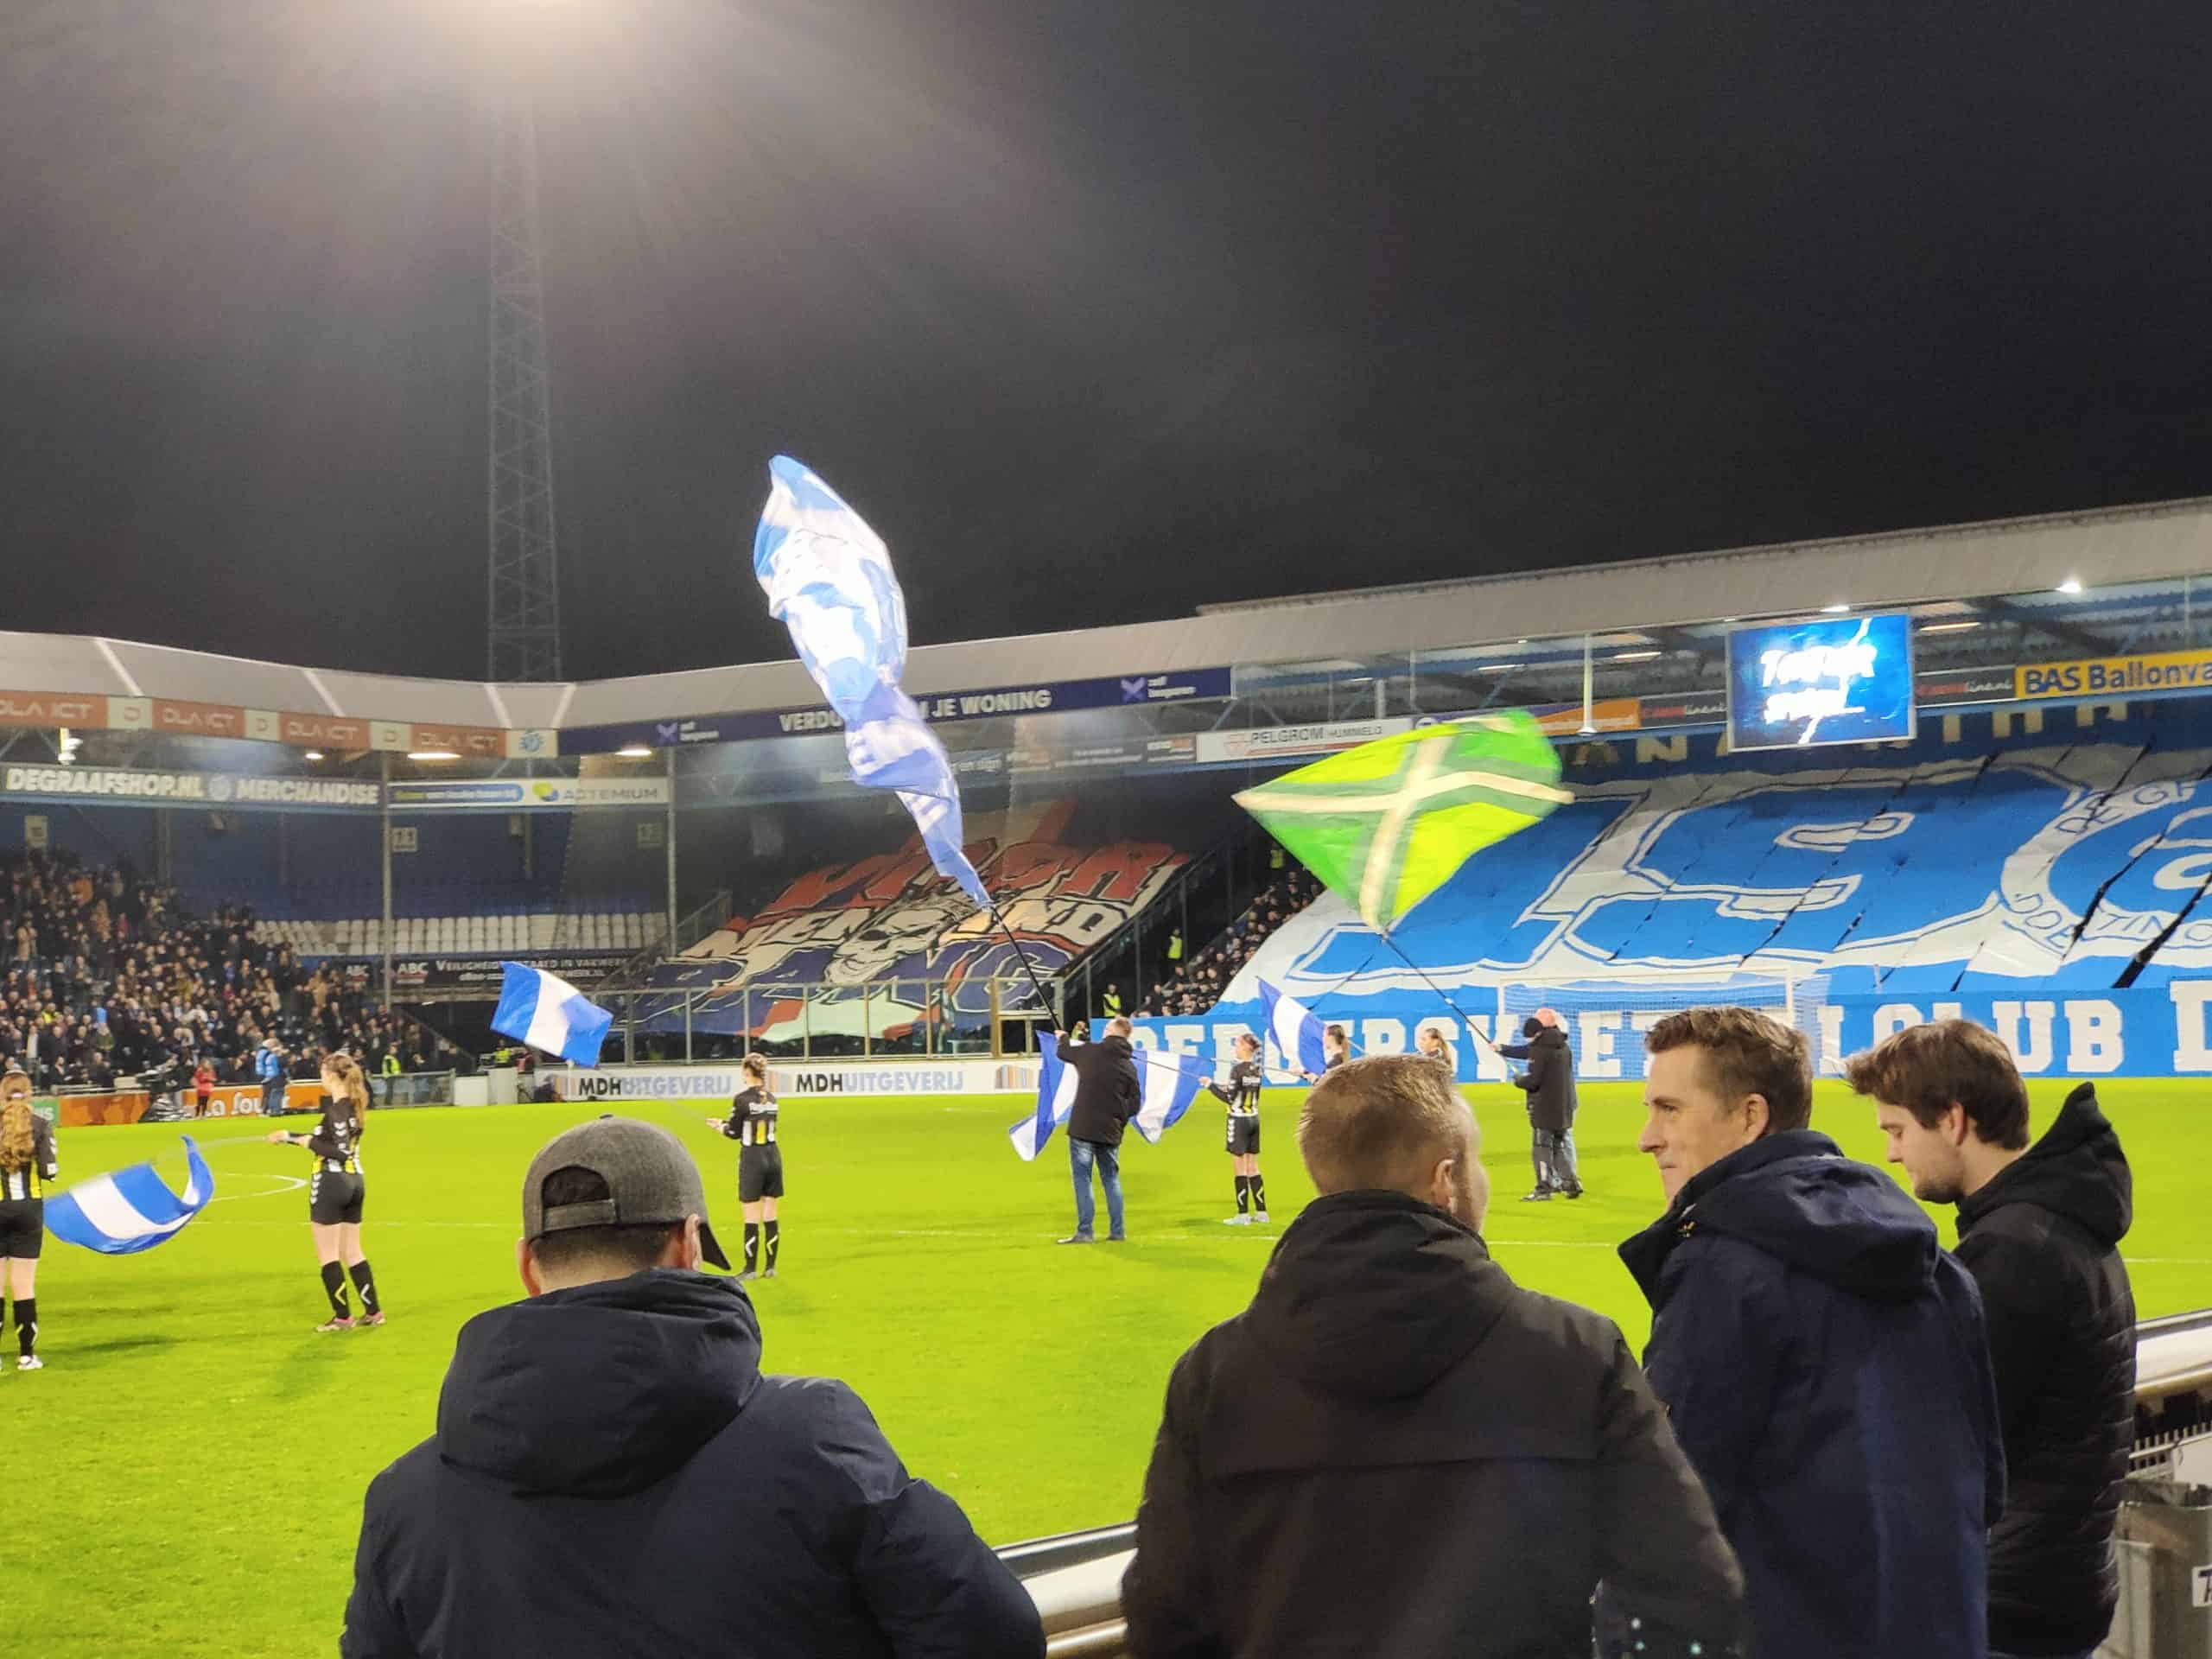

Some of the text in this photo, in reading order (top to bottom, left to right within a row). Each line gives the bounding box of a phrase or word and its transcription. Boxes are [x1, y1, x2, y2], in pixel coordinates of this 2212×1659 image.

[2024, 666, 2081, 693] BAS
[932, 698, 957, 718] JE
[960, 690, 1052, 714] WONING
[1250, 726, 1325, 744] PELGROM
[6, 768, 379, 804] DEGRAAFSHOP.NL MERCHANDISE
